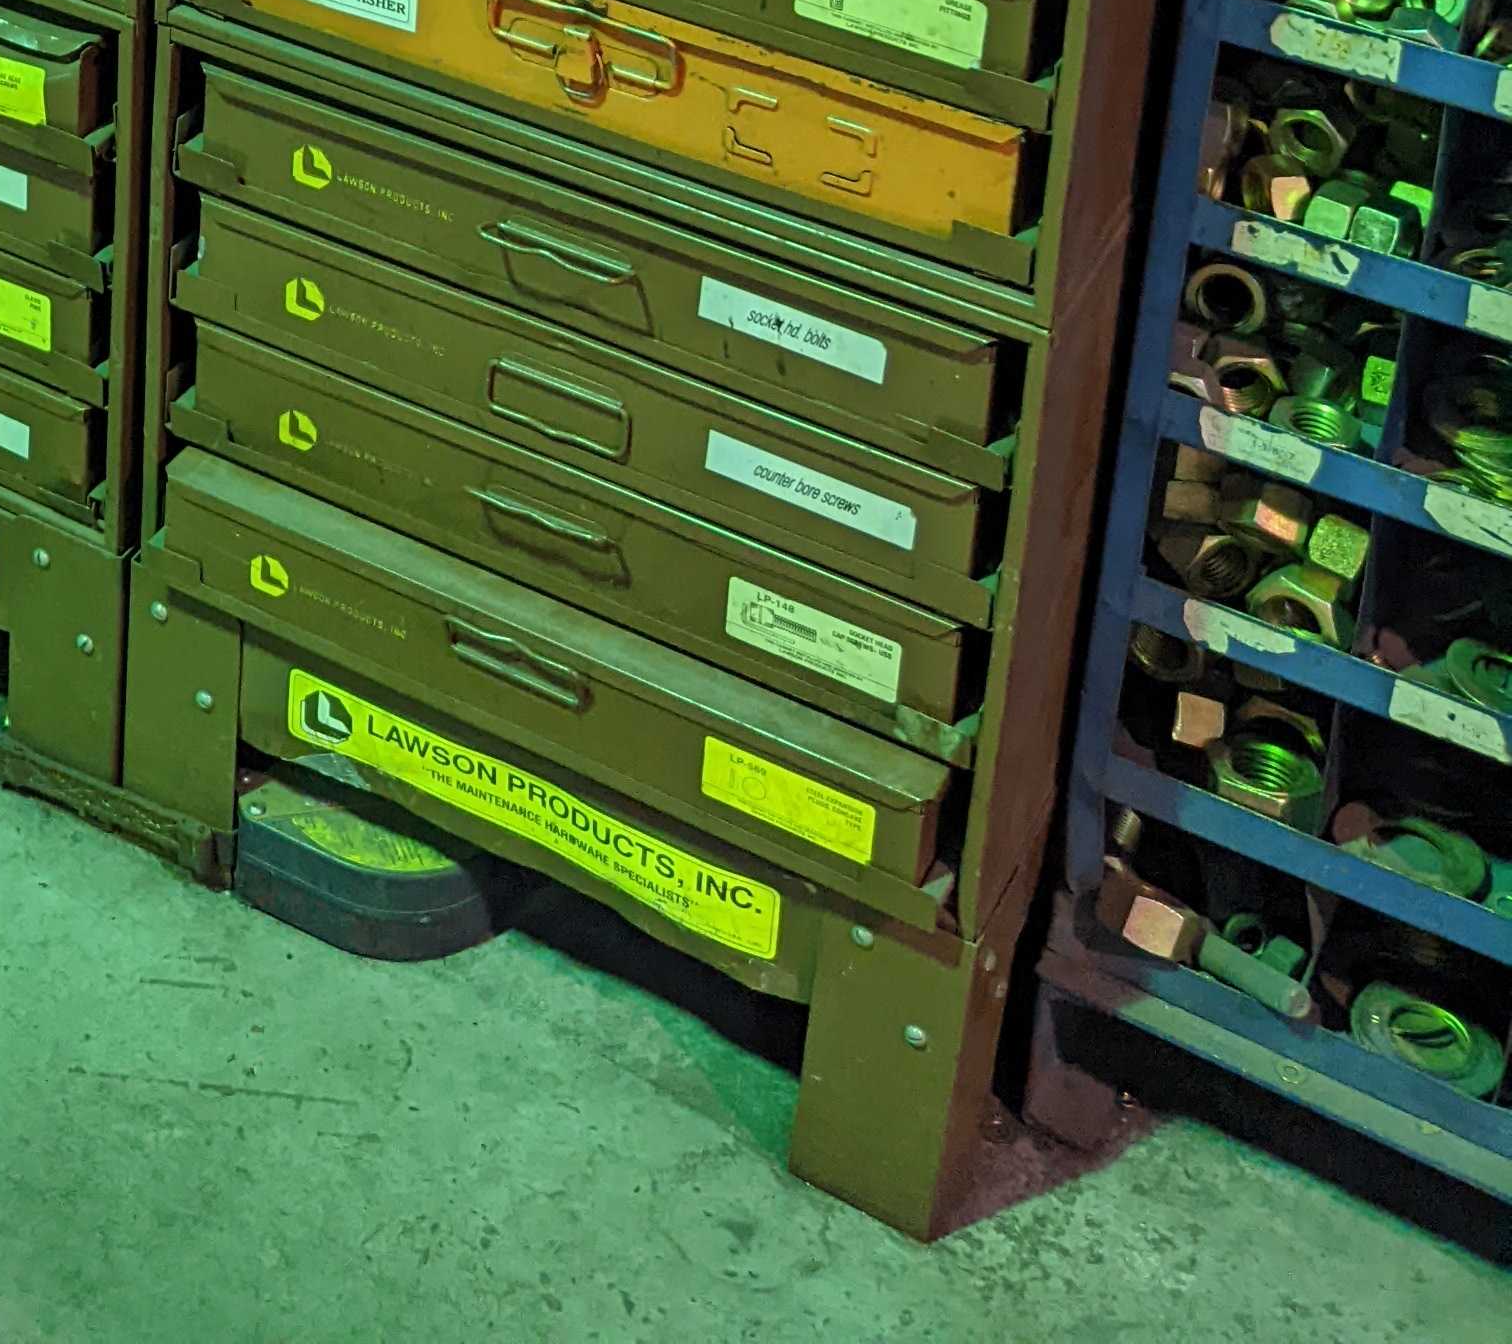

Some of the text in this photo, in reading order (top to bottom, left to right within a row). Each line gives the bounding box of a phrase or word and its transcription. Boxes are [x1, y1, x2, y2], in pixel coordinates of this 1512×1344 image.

[803, 328, 831, 350] bolts
[753, 464, 861, 516] counter bore screws
[367, 714, 763, 914] LAWSON PRODUCTS, INC.
[456, 779, 542, 826] MAINTENANCE
[543, 817, 611, 867] HARDWARE
